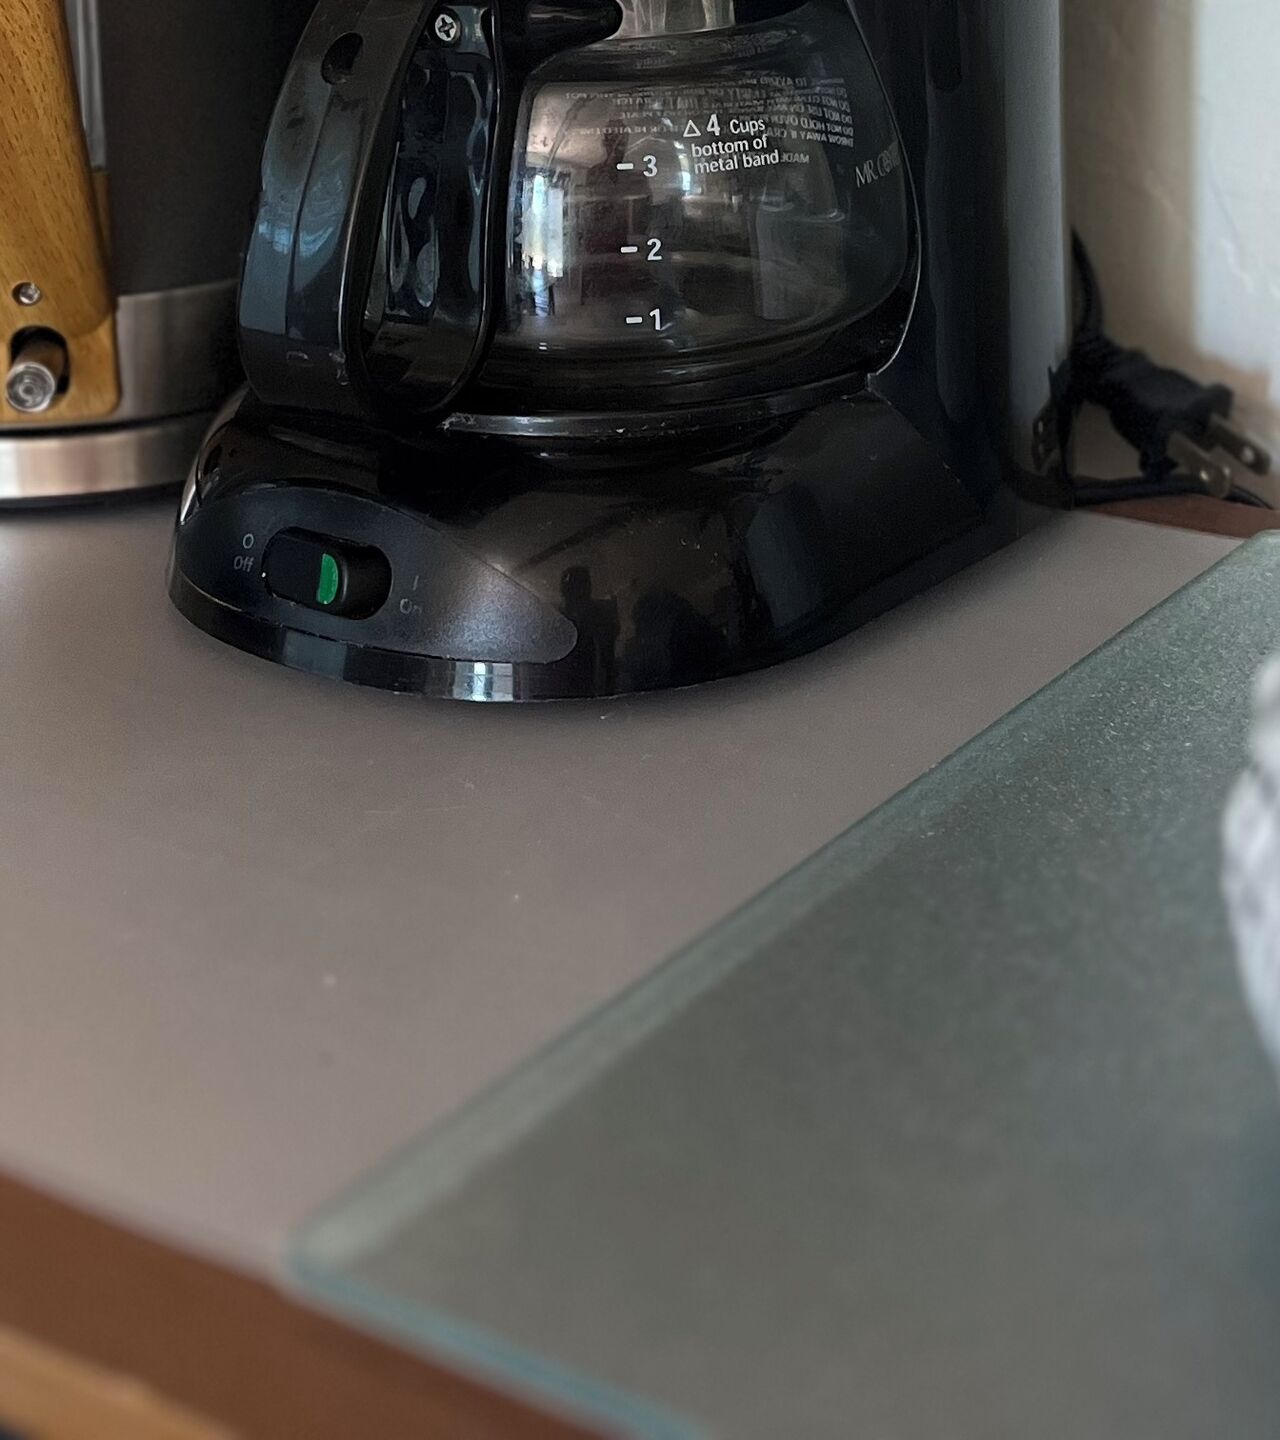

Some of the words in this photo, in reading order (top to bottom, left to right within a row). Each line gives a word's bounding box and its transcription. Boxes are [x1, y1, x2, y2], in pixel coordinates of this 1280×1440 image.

[706, 114, 721, 137] 4
[729, 117, 766, 137] Cups
[691, 137, 750, 158] bottom
[752, 134, 769, 152] of
[642, 155, 658, 177] 3
[694, 153, 740, 176] metal
[742, 149, 780, 171] band
[646, 238, 663, 261] 2
[649, 308, 663, 331] 1
[233, 554, 255, 573] Off
